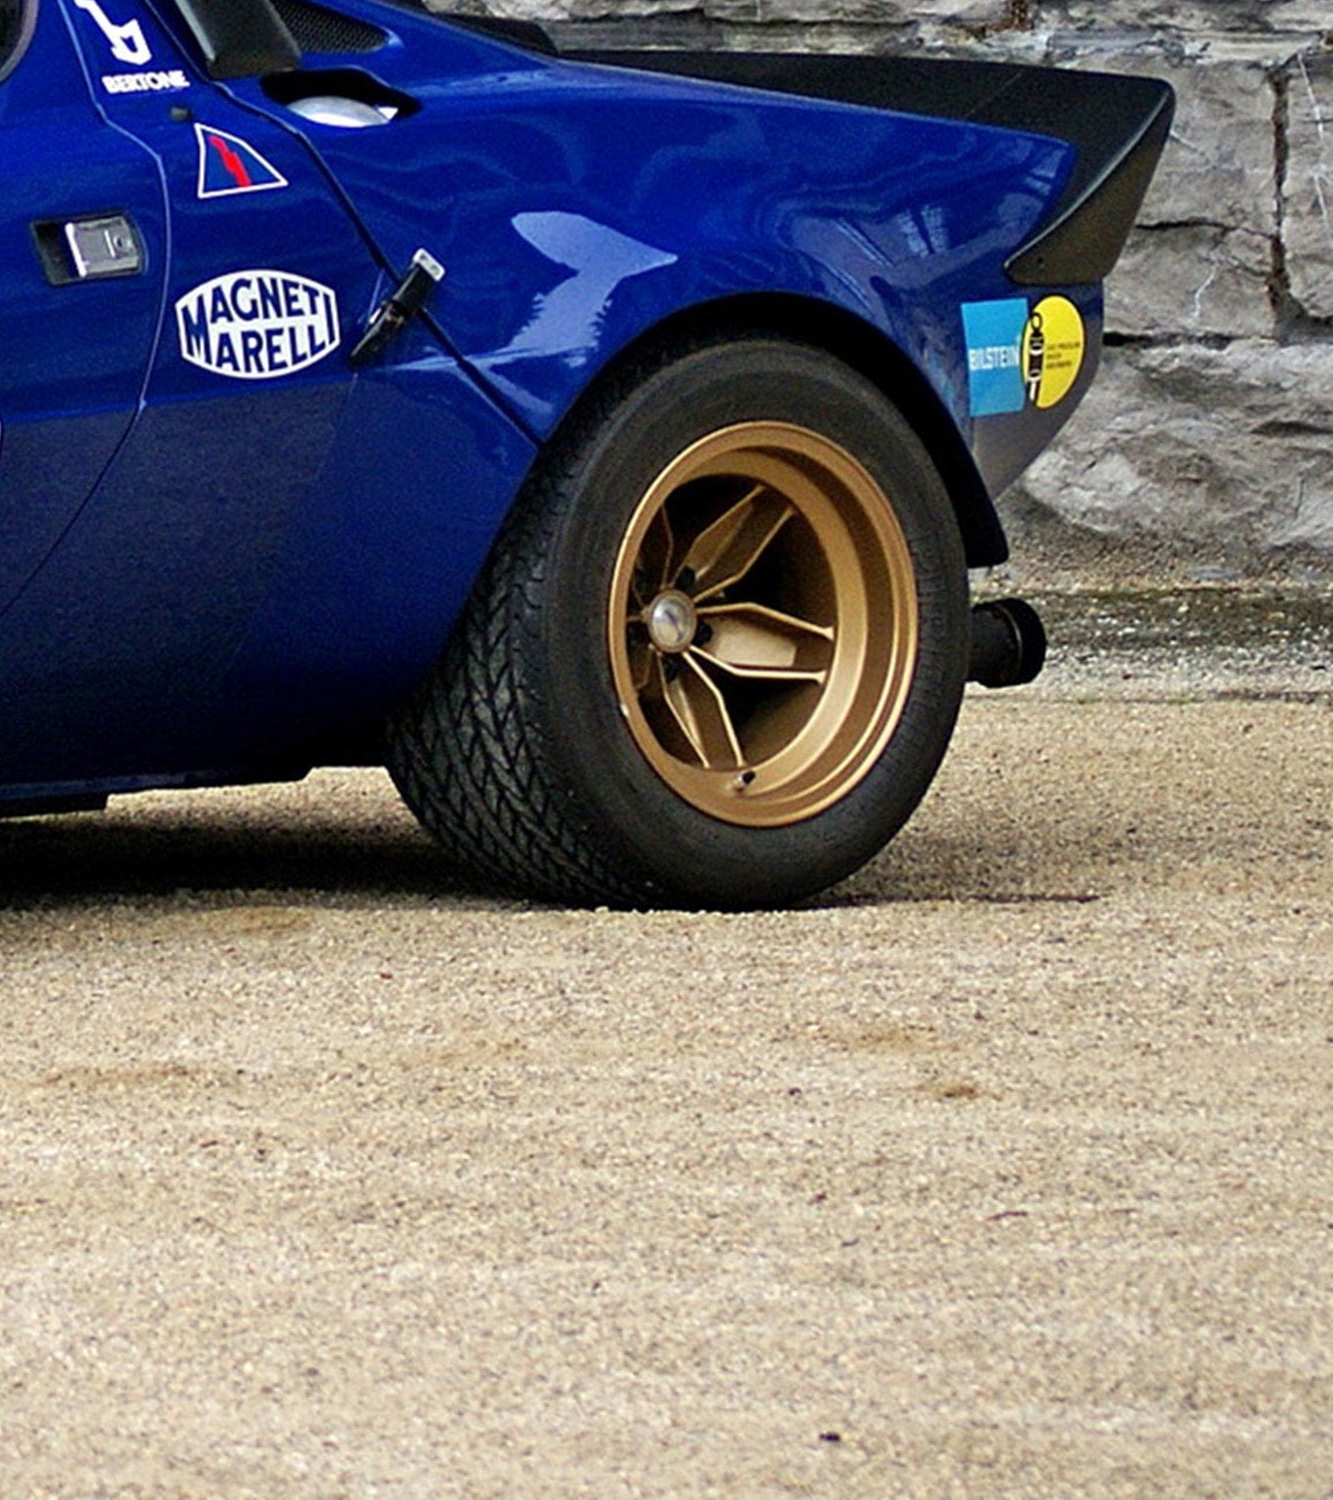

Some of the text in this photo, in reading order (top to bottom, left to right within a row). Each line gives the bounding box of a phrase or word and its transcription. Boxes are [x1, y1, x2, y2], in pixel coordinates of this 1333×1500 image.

[101, 70, 190, 94] BERTONE
[181, 277, 336, 357] MAGNETI
[181, 298, 336, 373] MARELLI
[968, 346, 1020, 371] BILSTEIN
